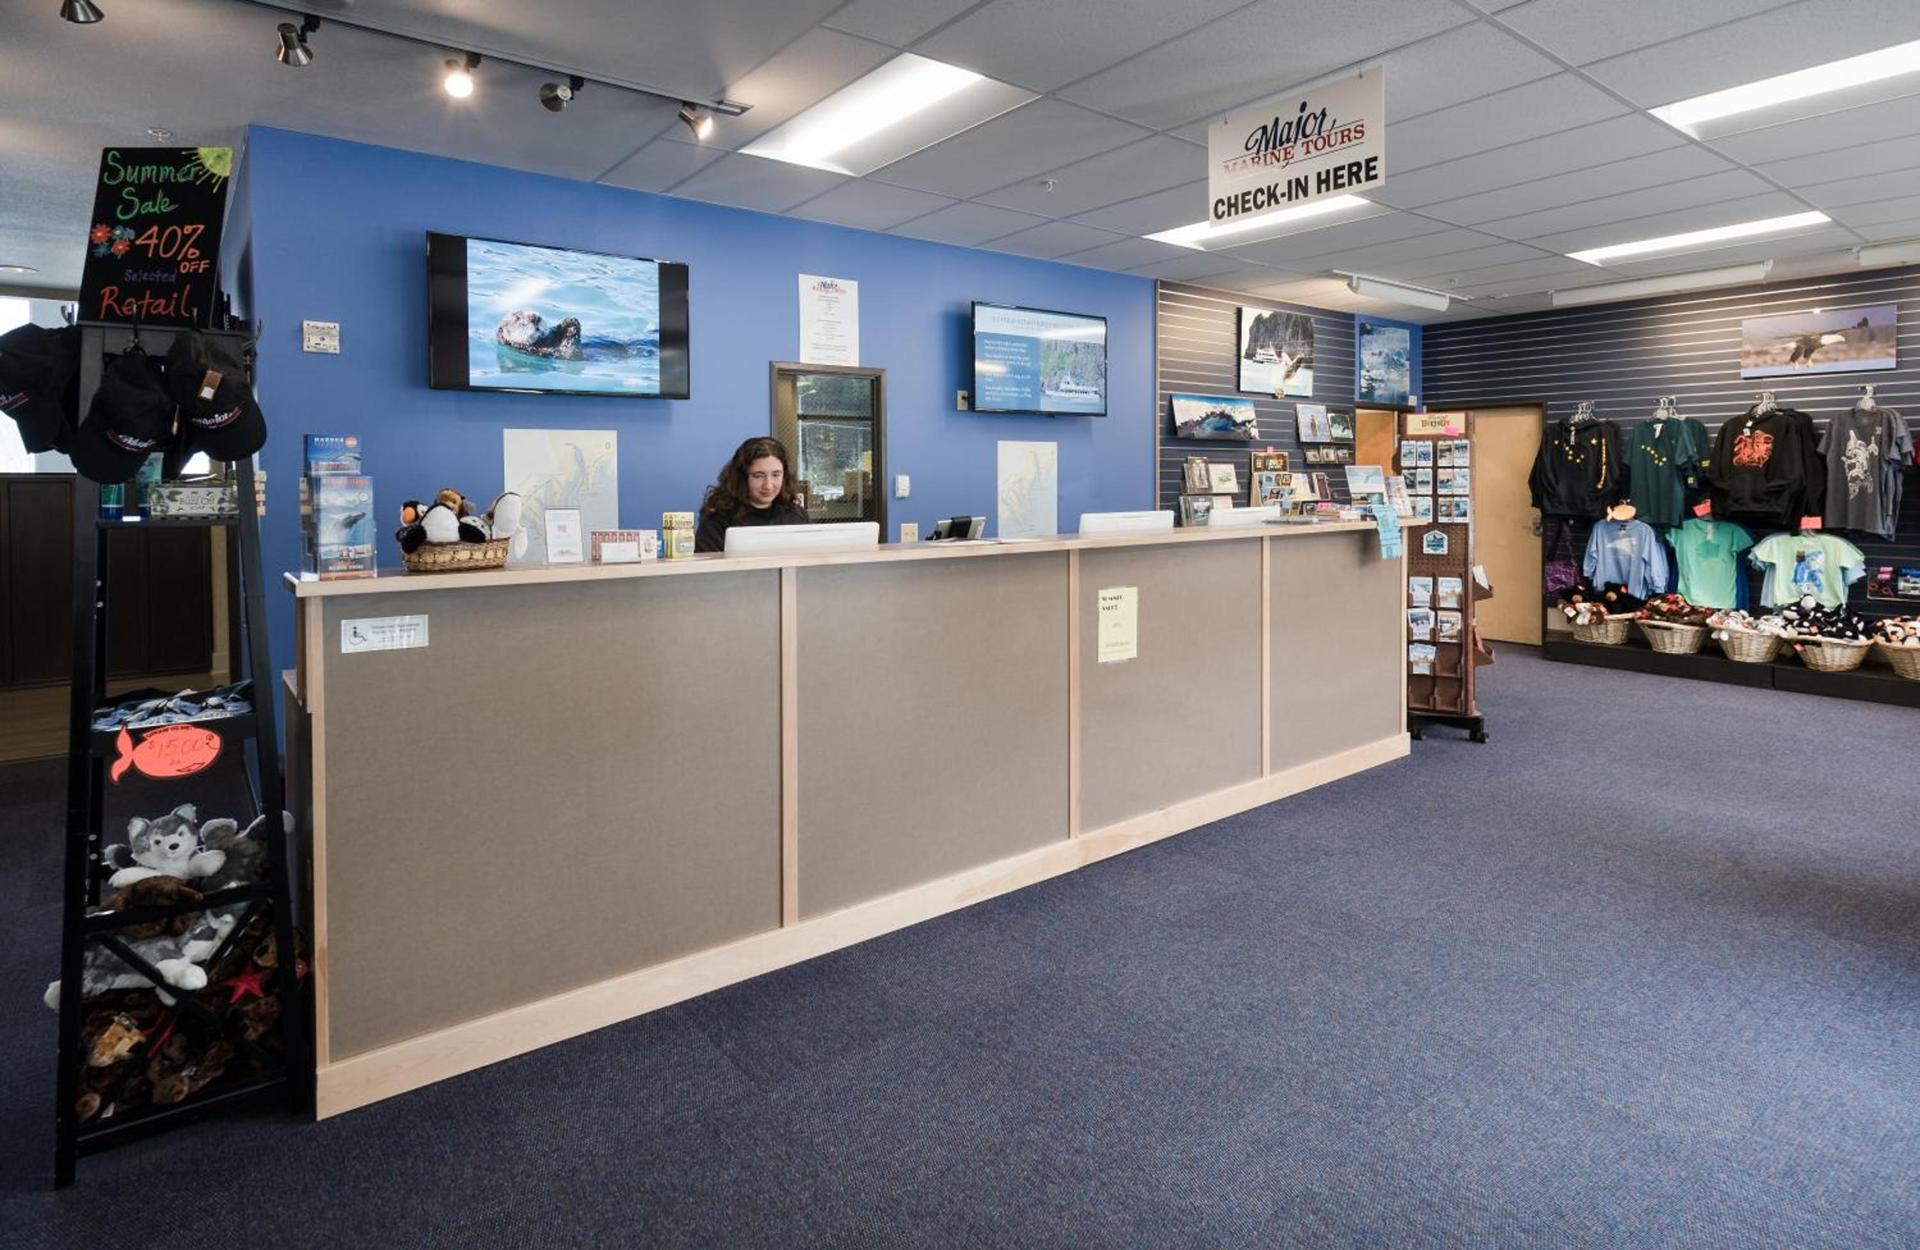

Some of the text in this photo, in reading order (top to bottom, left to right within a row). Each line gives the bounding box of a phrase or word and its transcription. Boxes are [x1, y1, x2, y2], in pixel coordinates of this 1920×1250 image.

[1245, 101, 1336, 155] Major
[1302, 123, 1365, 156] TOURS
[103, 151, 199, 185] Summer
[116, 187, 179, 220] Sale
[1214, 156, 1378, 220] CHECK-IN HERE
[135, 224, 205, 259] 40%
[124, 269, 177, 283] Selected
[180, 260, 210, 274] OFF
[99, 284, 191, 320] Retail
